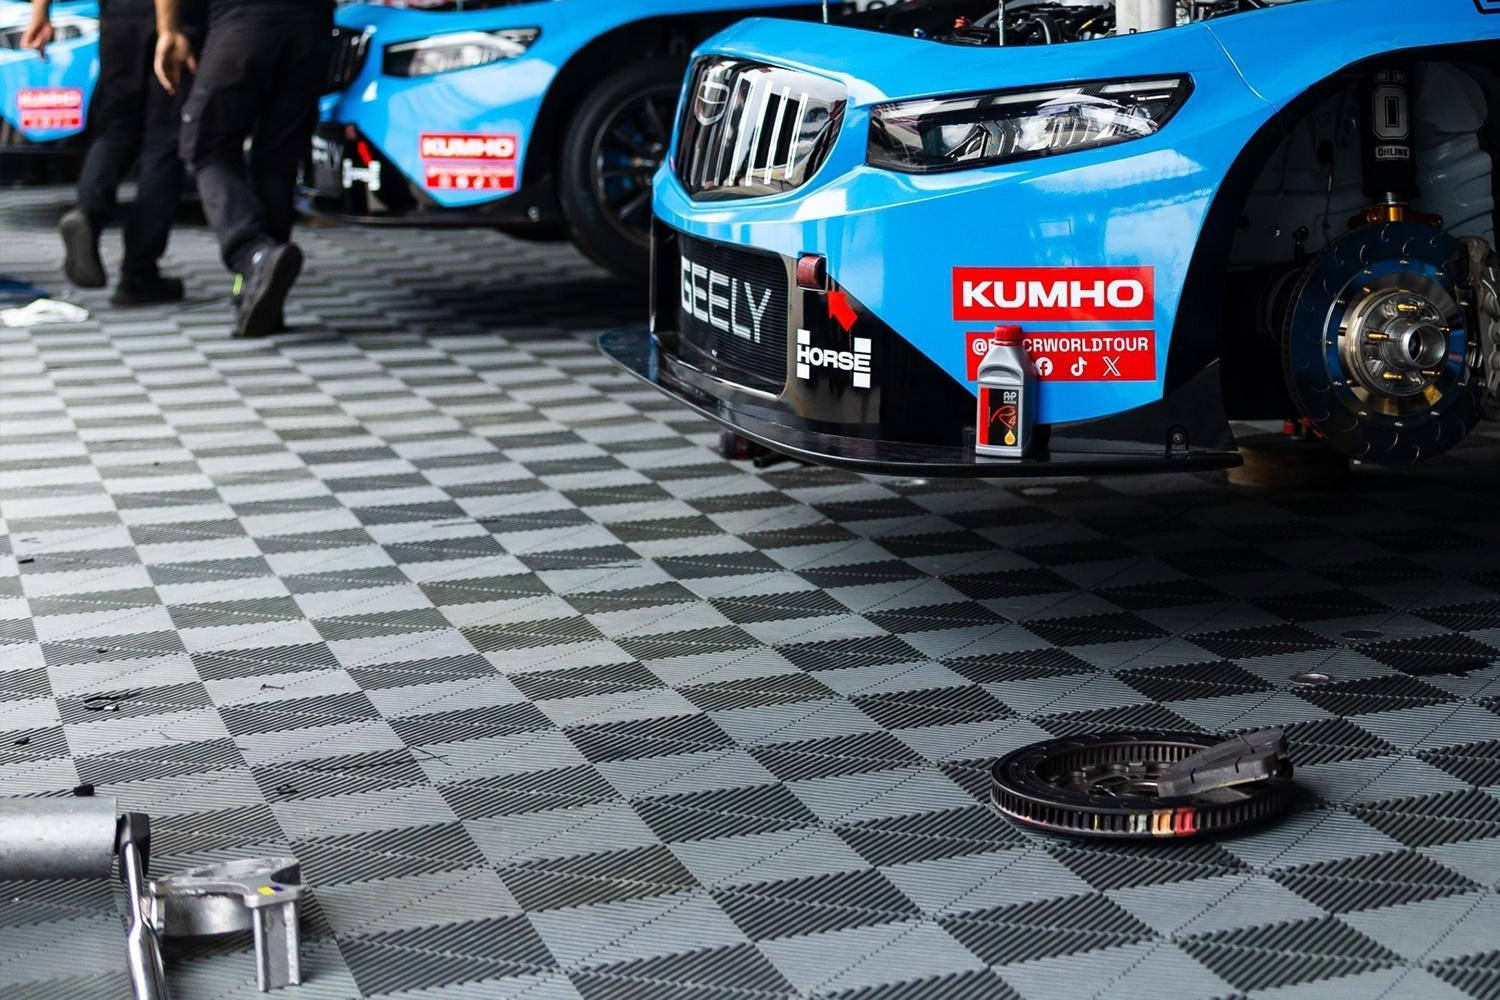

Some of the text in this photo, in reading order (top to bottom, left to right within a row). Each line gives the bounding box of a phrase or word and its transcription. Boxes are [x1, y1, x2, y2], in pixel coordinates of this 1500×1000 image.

[422, 137, 515, 158] KUMHO
[681, 255, 772, 344] GEELY
[962, 279, 1144, 308] KUMHO
